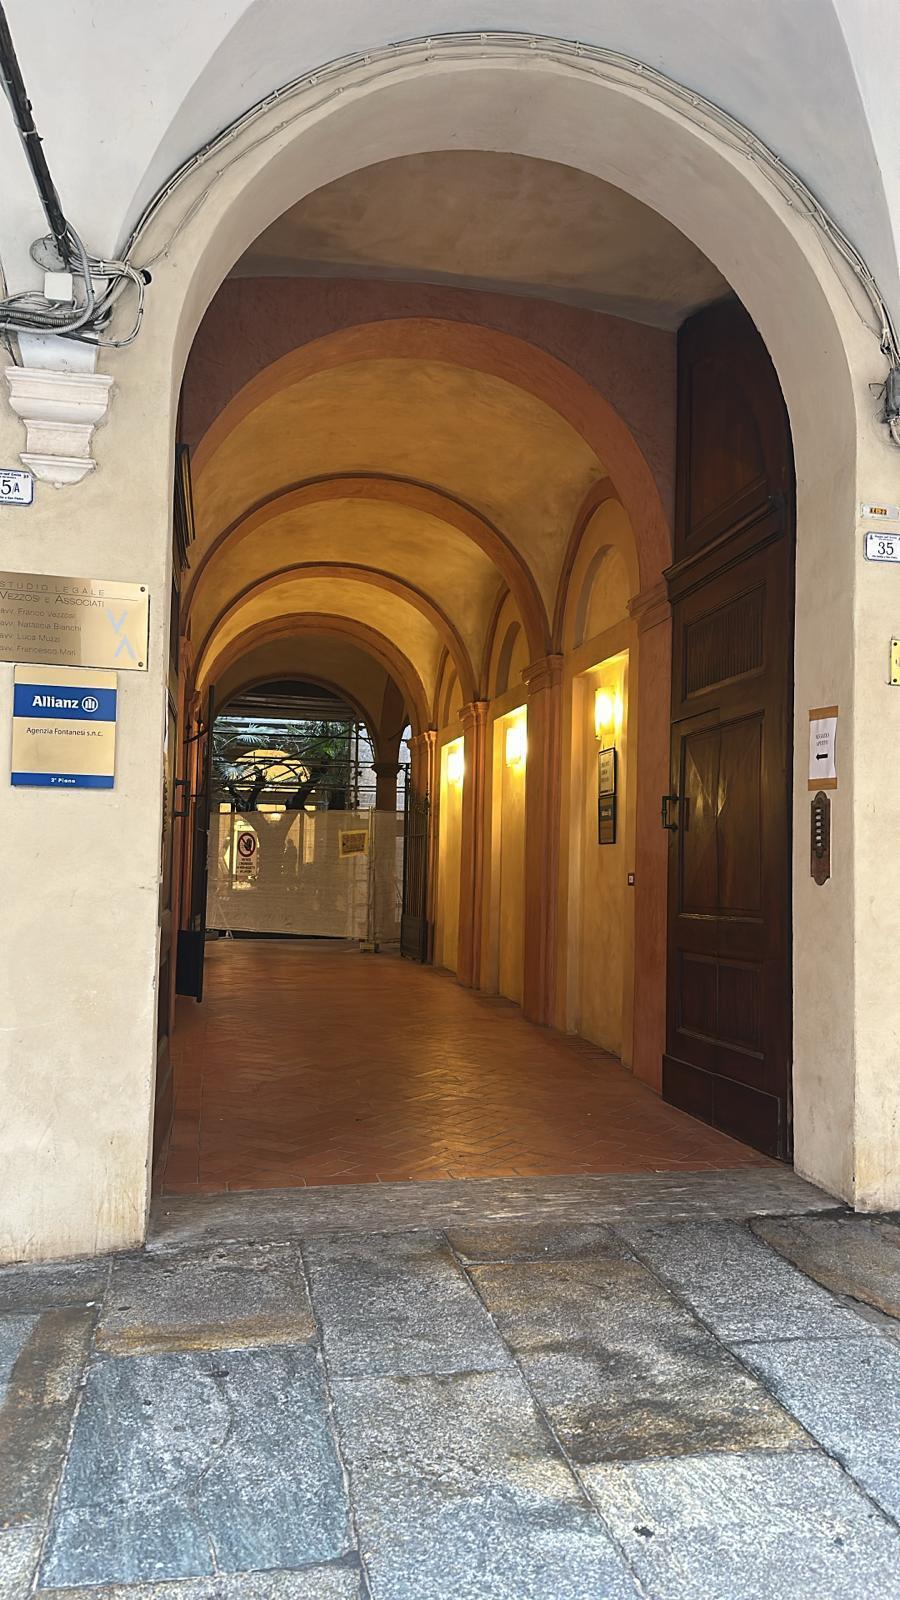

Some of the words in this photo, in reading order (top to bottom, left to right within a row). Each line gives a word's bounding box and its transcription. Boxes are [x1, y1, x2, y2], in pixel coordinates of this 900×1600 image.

[877, 541, 894, 555] 35
[0, 581, 49, 591] STUDIO
[55, 586, 105, 596] LEGALE
[55, 595, 105, 608] ASSOCIATI
[18, 608, 44, 616] Franco
[53, 622, 81, 632] Bianchi
[17, 645, 57, 655] Francesco
[32, 695, 79, 709] Allianz
[26, 727, 53, 736] Agenzia
[54, 728, 85, 736] Fontanesi
